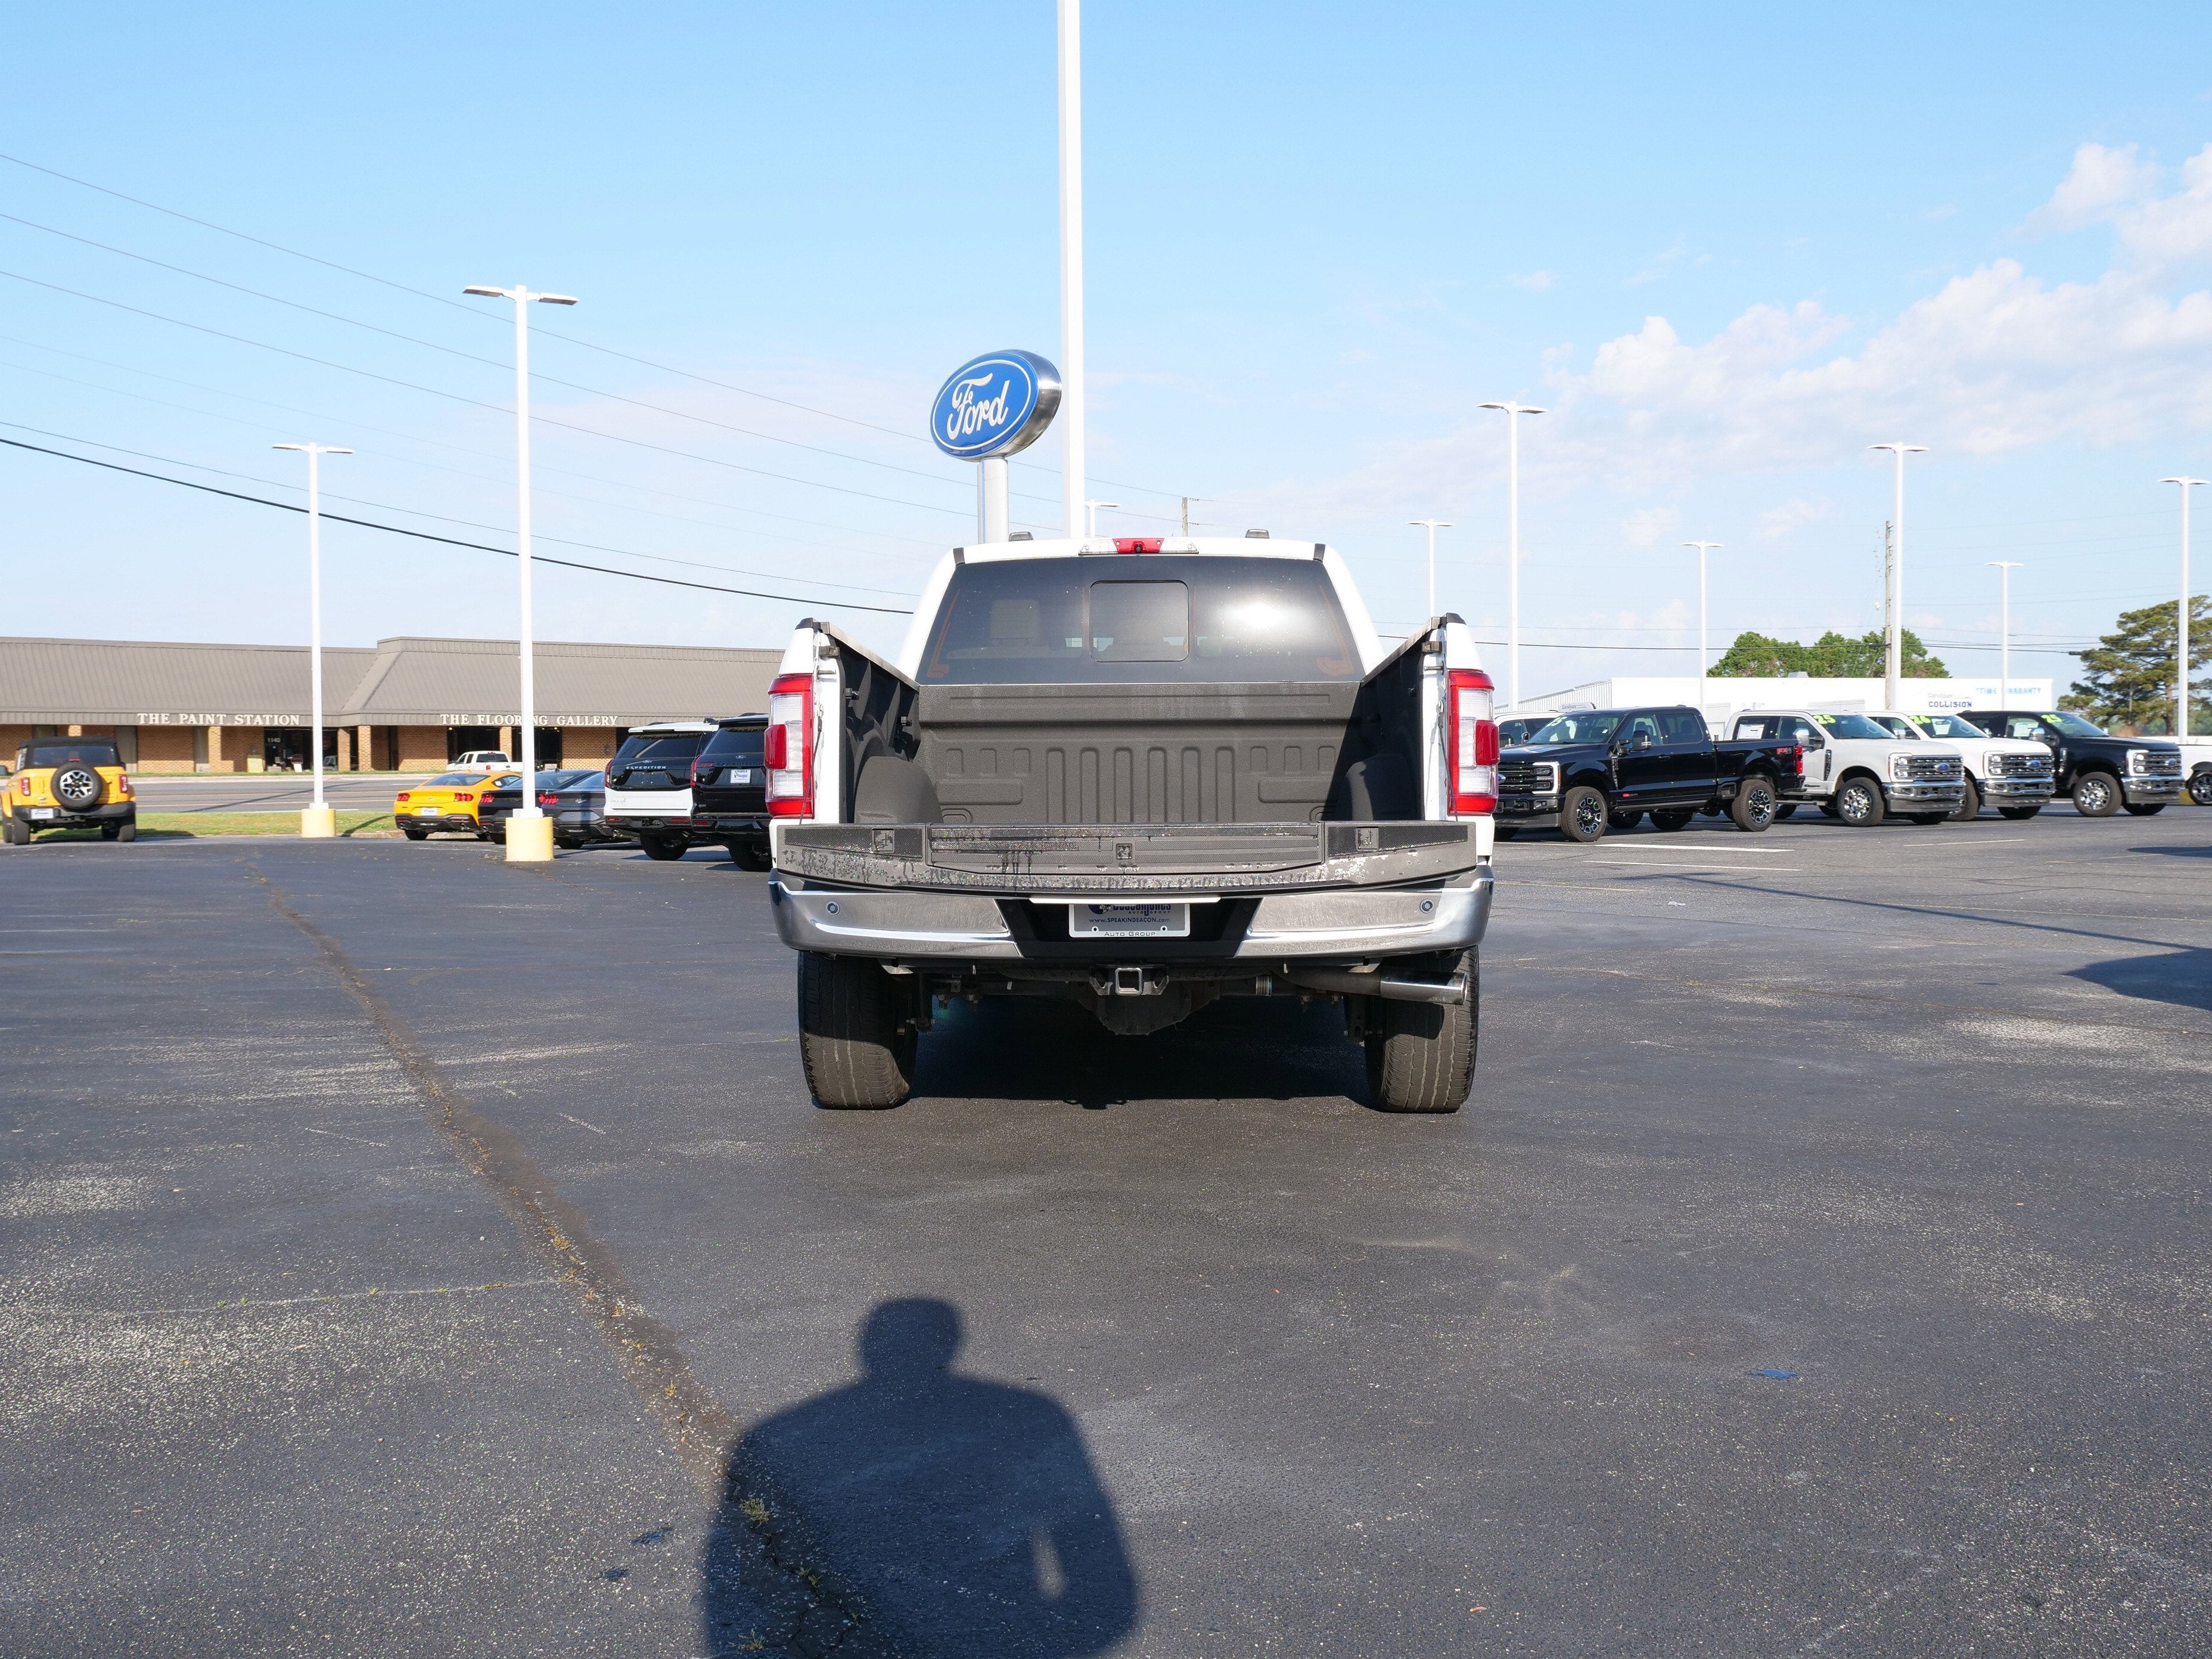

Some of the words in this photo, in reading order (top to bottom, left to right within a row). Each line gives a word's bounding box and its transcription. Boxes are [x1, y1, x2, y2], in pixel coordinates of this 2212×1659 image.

[946, 372, 1010, 440] Ford
[137, 713, 170, 725] THE
[179, 713, 227, 725] PAINT
[234, 714, 300, 726] STATION
[440, 714, 470, 725] THE
[477, 714, 548, 726] FLOORNG
[557, 715, 619, 726] GALLERY
[1813, 714, 1837, 725] 25
[2040, 714, 2064, 724] 25
